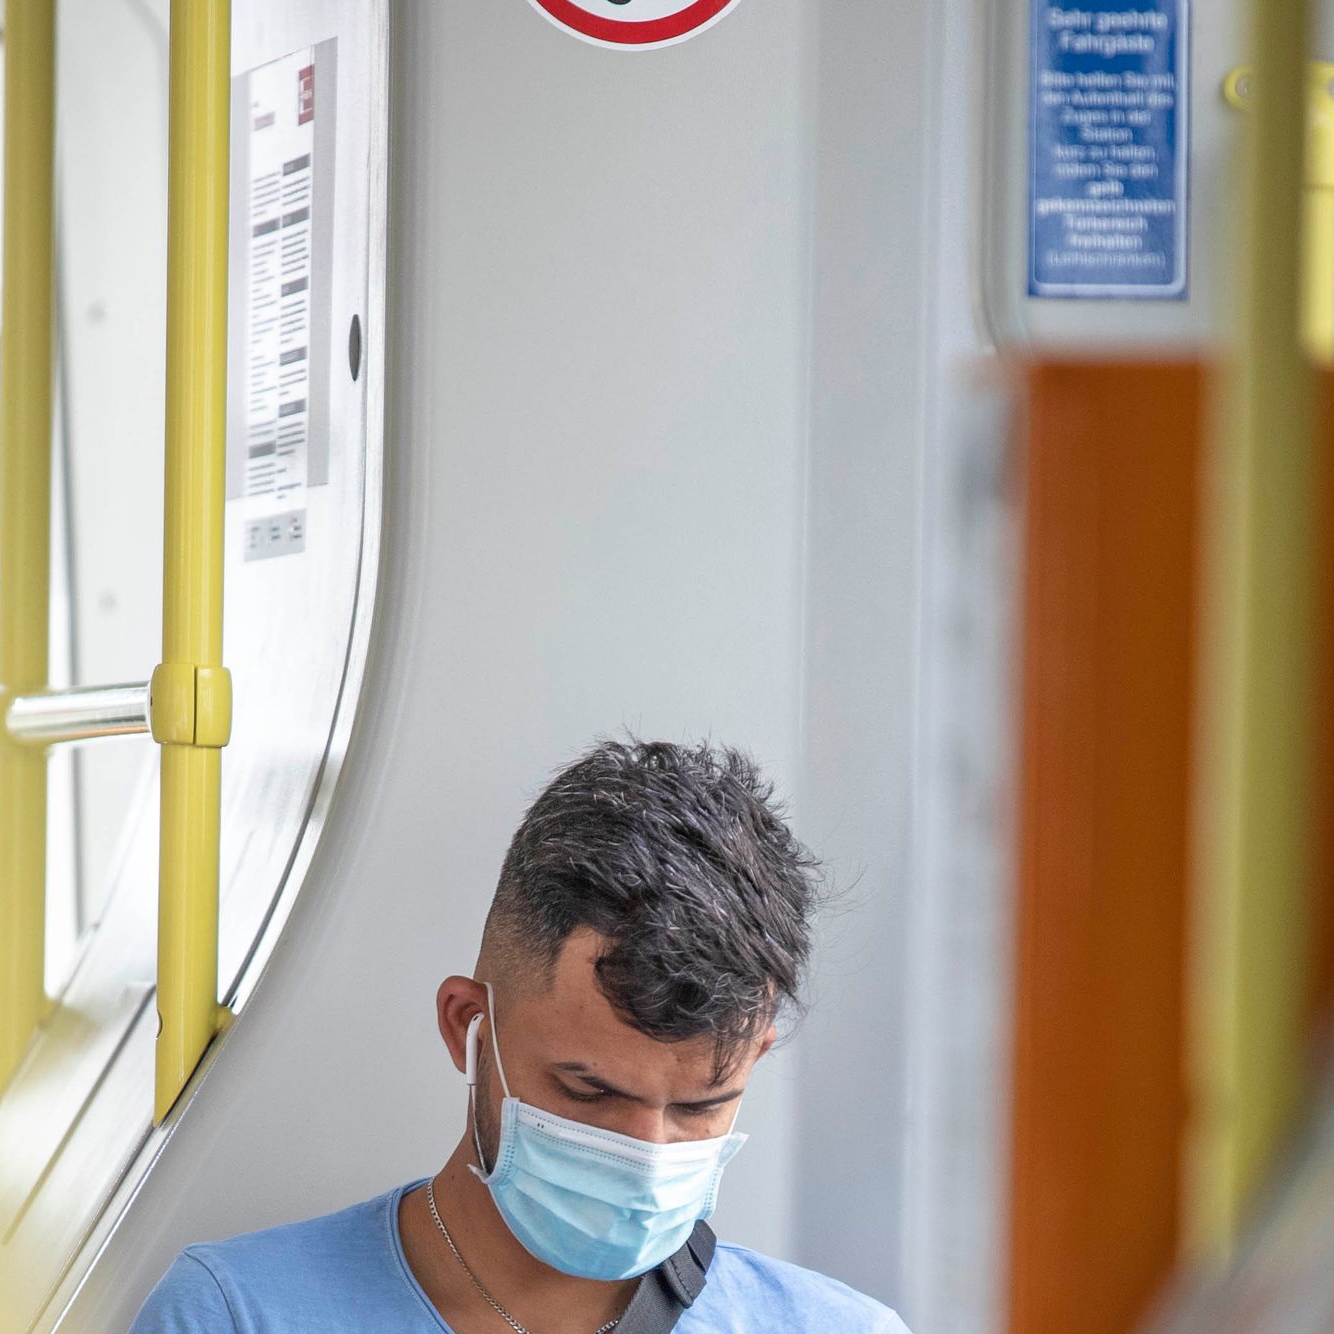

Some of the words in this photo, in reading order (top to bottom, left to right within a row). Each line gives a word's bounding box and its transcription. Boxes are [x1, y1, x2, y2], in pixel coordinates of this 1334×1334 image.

[1048, 8, 1091, 28] Sehr
[1094, 10, 1168, 31] geehrte
[1058, 32, 1155, 57] Fahrgäste
[1122, 71, 1149, 88] Sie
[1079, 127, 1133, 143] Station
[1086, 180, 1124, 197] gelb
